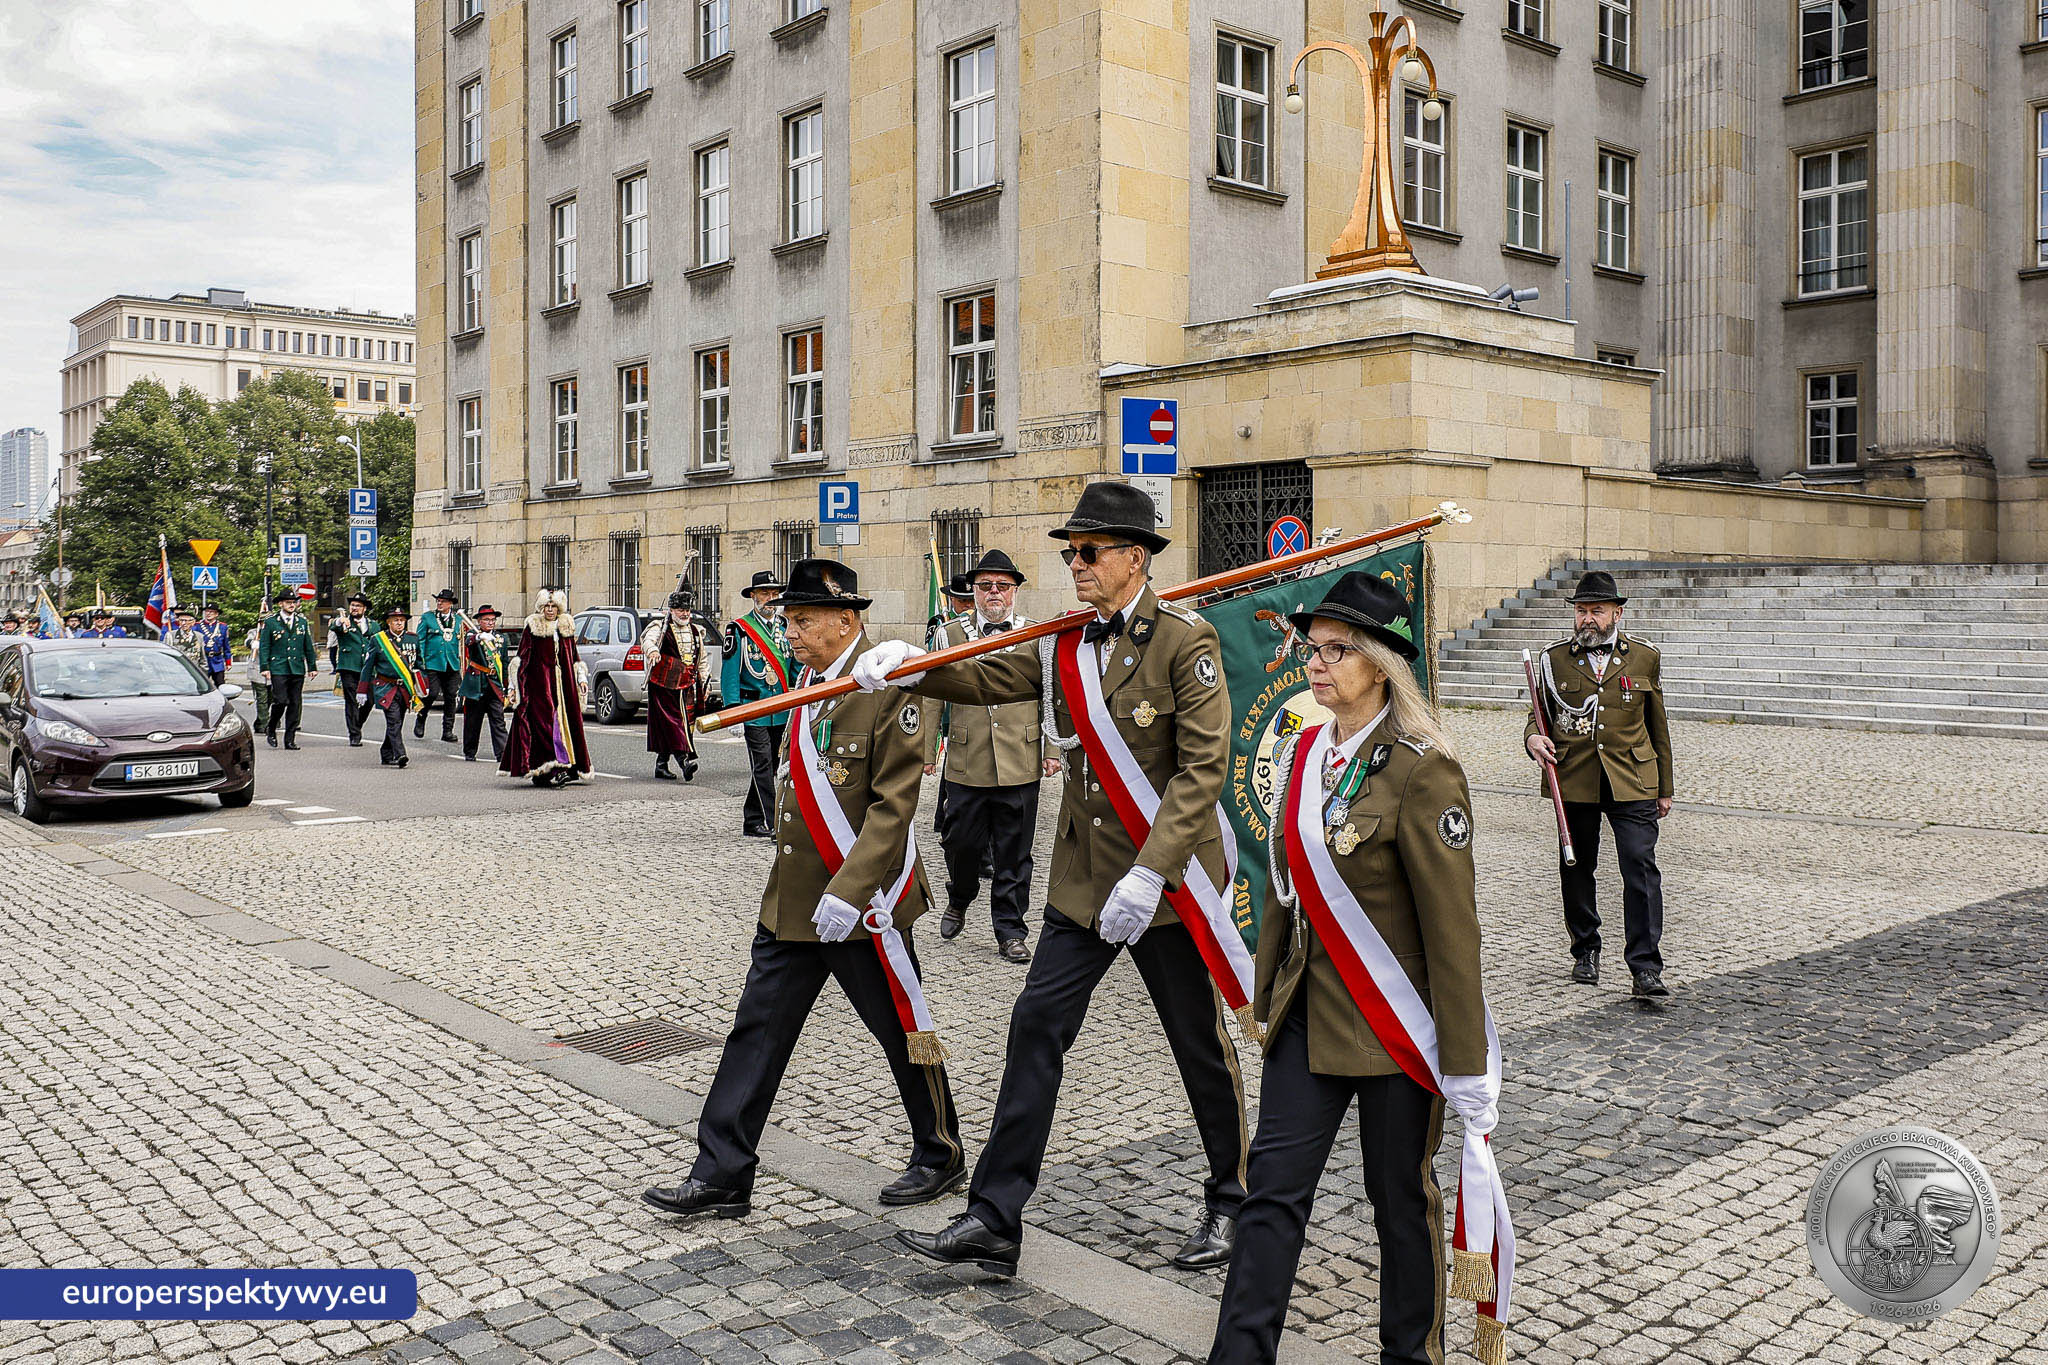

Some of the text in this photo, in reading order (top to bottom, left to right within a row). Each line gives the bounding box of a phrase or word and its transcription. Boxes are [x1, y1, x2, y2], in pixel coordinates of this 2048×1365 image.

[355, 491, 371, 512] P
[828, 486, 850, 519] P
[350, 517, 377, 525] Koniec
[287, 538, 299, 552] P
[356, 529, 372, 551] P
[134, 765, 153, 778] SK
[157, 763, 197, 777] 8810V
[1256, 755, 1274, 806] 1926
[1233, 754, 1267, 842] BRACTWO
[1233, 878, 1253, 931] 2011
